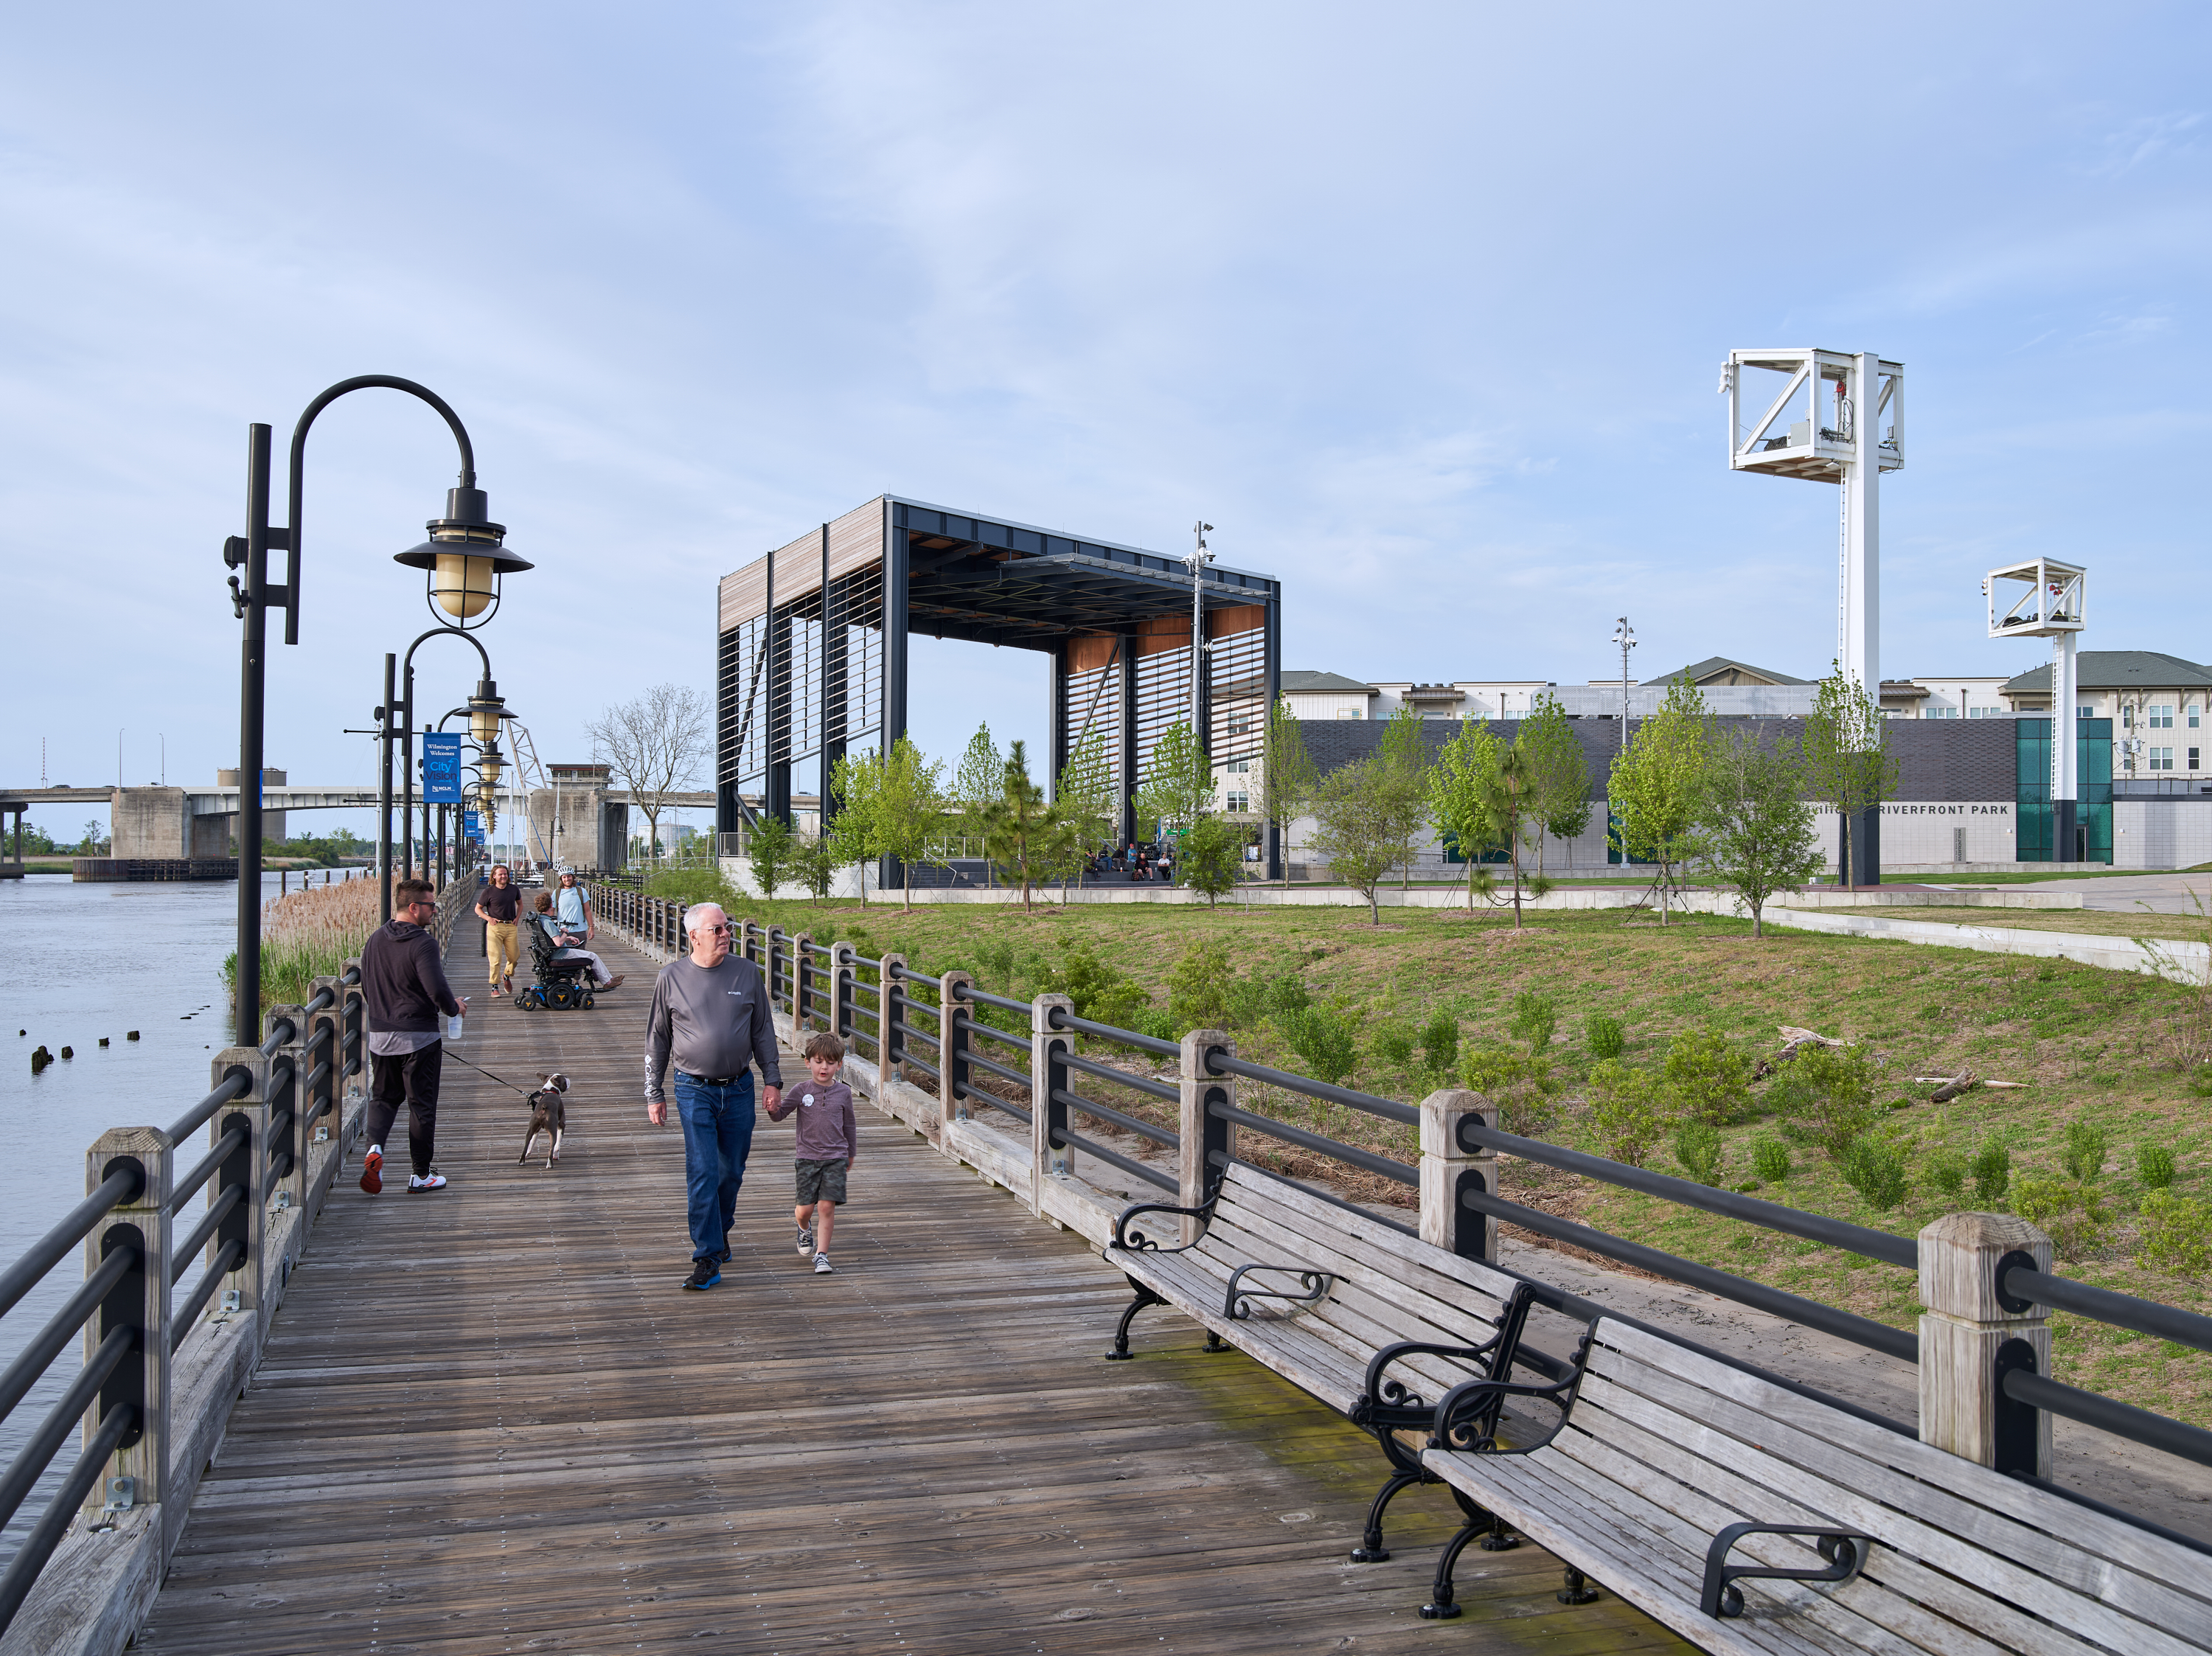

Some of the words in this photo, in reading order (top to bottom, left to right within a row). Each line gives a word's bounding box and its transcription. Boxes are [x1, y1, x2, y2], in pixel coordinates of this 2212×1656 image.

[430, 762, 451, 773] City
[425, 770, 457, 780] Vision
[1879, 805, 1964, 815] RIVERFRONT
[1971, 805, 2008, 815] PARK
